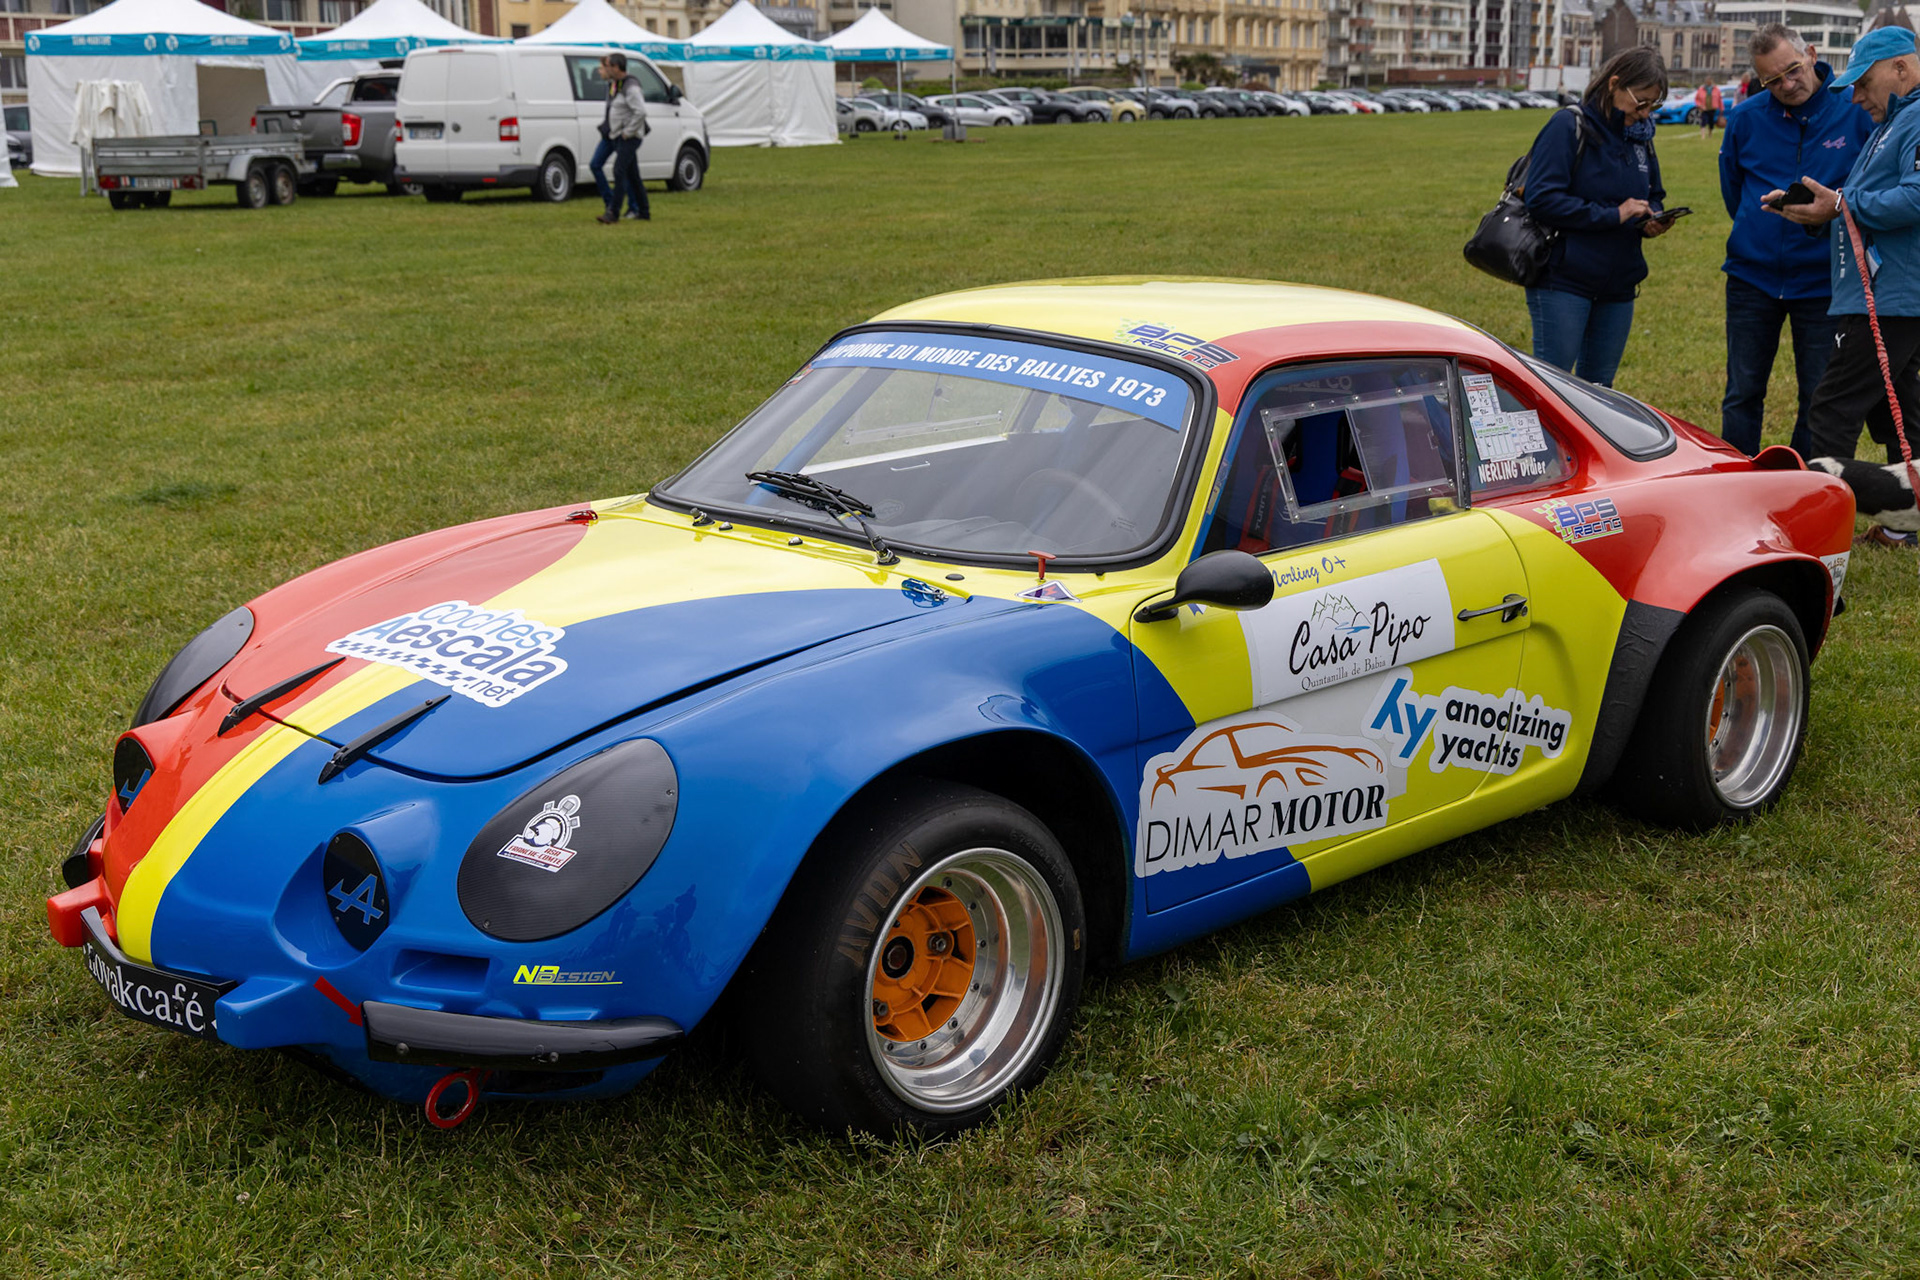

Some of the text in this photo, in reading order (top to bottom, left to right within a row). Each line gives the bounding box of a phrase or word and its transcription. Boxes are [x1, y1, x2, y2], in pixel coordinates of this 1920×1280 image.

[1127, 324, 1240, 364] BPS
[886, 344, 919, 360] DU
[911, 346, 981, 367] MONDE
[975, 353, 1020, 372] DES
[1015, 358, 1106, 388] RALLYES
[1107, 376, 1167, 407] 1973
[1478, 456, 1546, 484] NERLING Didier
[1554, 497, 1620, 528] BPS
[418, 603, 555, 649] coches
[1288, 601, 1432, 676] Casa Pipo
[356, 616, 557, 688] Aescala
[1301, 656, 1386, 691] Quintanilla de Babia
[464, 679, 516, 702] .net
[1446, 700, 1566, 751] anodizing
[1438, 734, 1521, 768] yachts
[1145, 784, 1386, 864] DIMAR MOTOR
[837, 841, 923, 968] AVON
